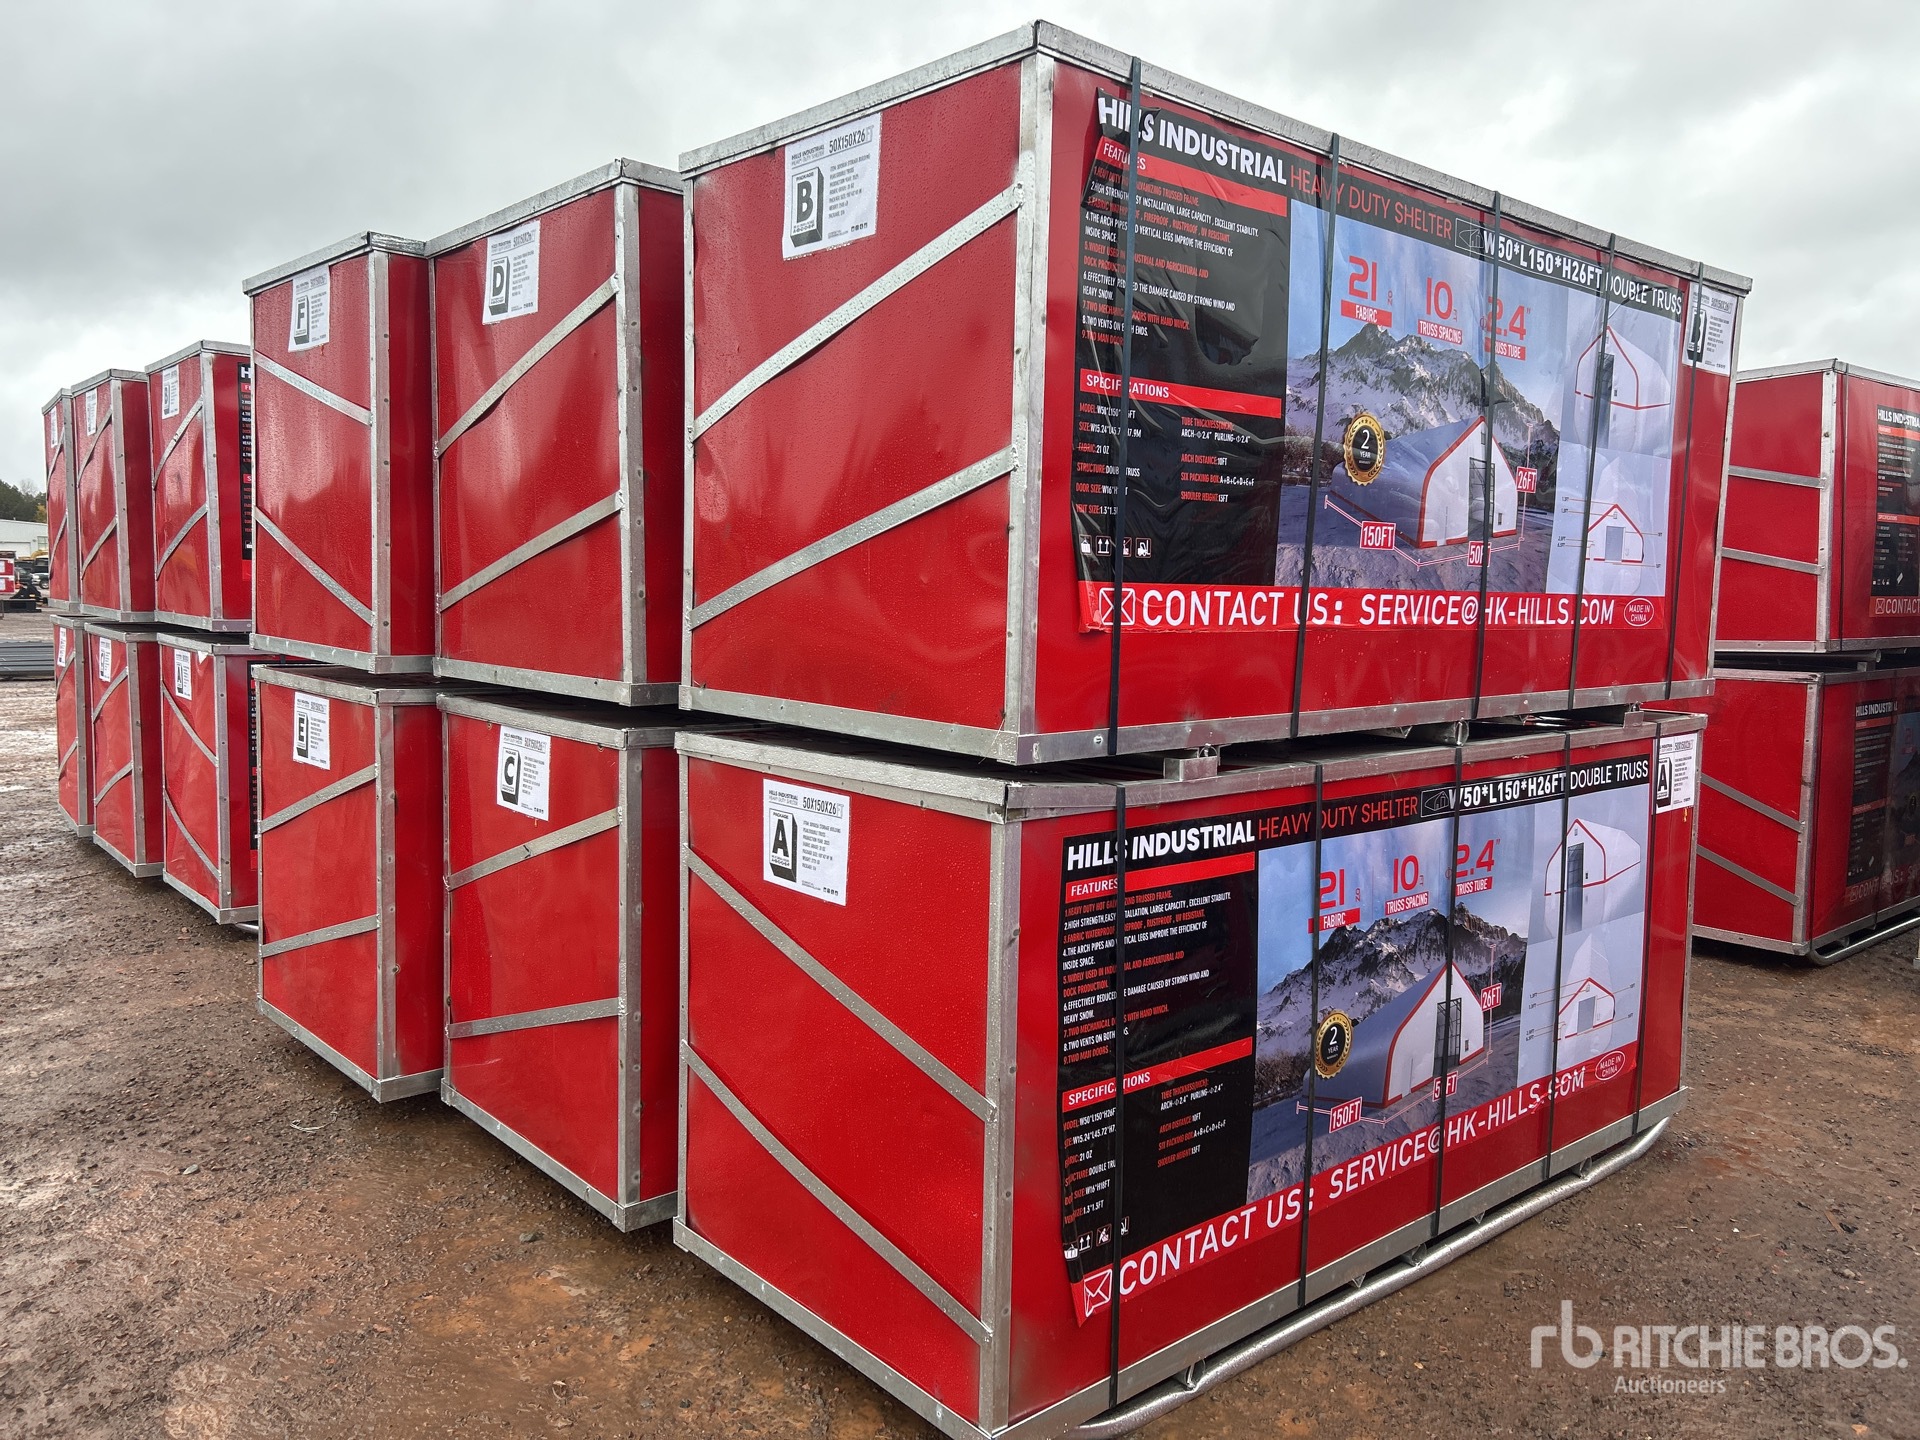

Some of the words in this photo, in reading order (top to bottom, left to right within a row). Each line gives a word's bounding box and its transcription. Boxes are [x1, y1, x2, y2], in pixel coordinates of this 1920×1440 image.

[797, 181, 813, 223] B
[1160, 120, 1286, 185] INDUSTRIAL
[1350, 186, 1390, 219] DUTY
[1395, 204, 1451, 239] SHELTER
[1652, 287, 1681, 314] TRUSS
[1176, 206, 1190, 217] LARGE
[1215, 217, 1236, 231] EXCELLENT
[1085, 226, 1100, 239] INSIDE
[1100, 215, 1113, 227] ARCH
[1115, 219, 1127, 231] PIPES
[1140, 225, 1161, 239] VERTICAL
[1163, 231, 1173, 242] LEGS
[1175, 235, 1194, 247] IMPROVE
[1204, 242, 1227, 255] EFFICIENCY
[1084, 256, 1097, 267] DOCK
[1156, 258, 1165, 268] AND
[492, 266, 504, 297] D
[1349, 256, 1377, 301] 21
[1083, 285, 1097, 297] HEAVY
[1149, 285, 1169, 297] DAMAGE
[1170, 290, 1186, 302] CAUSED
[1187, 294, 1193, 302] BY
[1194, 296, 1212, 307] STRONG
[1213, 299, 1225, 309] WIND
[1226, 302, 1235, 311] AND
[1426, 277, 1453, 320] 10
[297, 302, 305, 329] F
[1098, 318, 1112, 329] VENTS
[1114, 322, 1120, 331] ON
[1148, 314, 1160, 324] WITH
[1160, 317, 1173, 327] HAND
[1420, 320, 1438, 337] TRUSS
[1439, 326, 1462, 344] SPACING
[1508, 344, 1520, 358] TUBE
[1878, 409, 1892, 422] HILLS
[1361, 430, 1369, 449] 2
[1103, 446, 1109, 454] OZ
[1181, 454, 1194, 462] ARCH
[1190, 473, 1209, 482] PACKING
[1518, 470, 1536, 492] 26FT
[1363, 526, 1394, 548] 150FT
[1143, 590, 1284, 626] CONTACT
[1629, 605, 1644, 613] MADE
[1631, 614, 1646, 622] CHINA
[299, 717, 304, 742] E
[504, 756, 515, 785] C
[1658, 764, 1667, 791] A
[1132, 820, 1255, 860] INDUSTRIAL
[1259, 812, 1311, 840] HEAVY
[1361, 796, 1418, 823] SHELTER
[1570, 765, 1612, 790] DOUBLE
[1616, 760, 1648, 782] TRUSS
[772, 819, 789, 857] A
[1393, 855, 1419, 894] 10
[1319, 868, 1345, 909] 21
[1456, 883, 1473, 896] TRUSS
[1474, 878, 1488, 891] TUBE
[1083, 903, 1095, 913] DUTY
[1136, 894, 1155, 903] TRUSSED
[1150, 905, 1164, 914] LARGE
[1189, 896, 1210, 907] EXCELLENT
[1387, 900, 1405, 915] TRUSS
[1405, 892, 1428, 911] SPACING
[1086, 926, 1115, 938] WATERPROOF
[1147, 915, 1172, 927] RUSTPROOF
[1176, 914, 1182, 922] UV
[1077, 944, 1090, 954] ARCH
[1092, 941, 1104, 951] PIPES
[1105, 939, 1115, 948] AND
[1138, 932, 1148, 942] LEGS
[1150, 929, 1169, 940] IMPROVE
[1179, 922, 1201, 933] EFFICIENCY
[1202, 921, 1207, 929] OF
[1063, 959, 1078, 970] INSIDE
[1085, 969, 1097, 979] USED
[1098, 968, 1103, 976] IN
[1132, 960, 1142, 969] AND
[1143, 953, 1174, 967] AGRICULTURAL
[1175, 951, 1184, 959] AND
[1063, 987, 1076, 998] DOCK
[1097, 991, 1117, 1003] REDUCED
[1128, 984, 1146, 996] DAMAGE
[1147, 980, 1164, 991] CAUSED
[1165, 978, 1171, 987] BY
[1172, 974, 1188, 985] STRONG
[1189, 972, 1200, 981] WIND
[1200, 970, 1209, 978] AND
[1482, 985, 1500, 1009] 26FT
[1064, 1013, 1078, 1024] HEAVY
[1080, 1019, 1110, 1034] MECHANICAL
[1128, 1011, 1139, 1021] WITH
[1140, 1008, 1152, 1018] HAND
[1080, 1036, 1094, 1047] VENTS
[1095, 1034, 1102, 1043] ON
[1103, 1030, 1115, 1041] BOTH
[1330, 1026, 1337, 1046] 2
[1080, 1050, 1091, 1061] MAN
[1328, 1045, 1339, 1054] YEAR
[1600, 1058, 1615, 1069] MADE
[1616, 1055, 1621, 1063] IN
[1602, 1065, 1618, 1077] CHINA
[1068, 1072, 1150, 1105] SPECIFICTIONS
[1161, 1090, 1172, 1100] TUBE
[1332, 1100, 1361, 1129] 150FT
[1160, 1123, 1171, 1134] ARCH
[1166, 1134, 1184, 1147] PACKING
[1086, 1150, 1092, 1159] OZ
[1120, 1207, 1256, 1295] CONTACT
